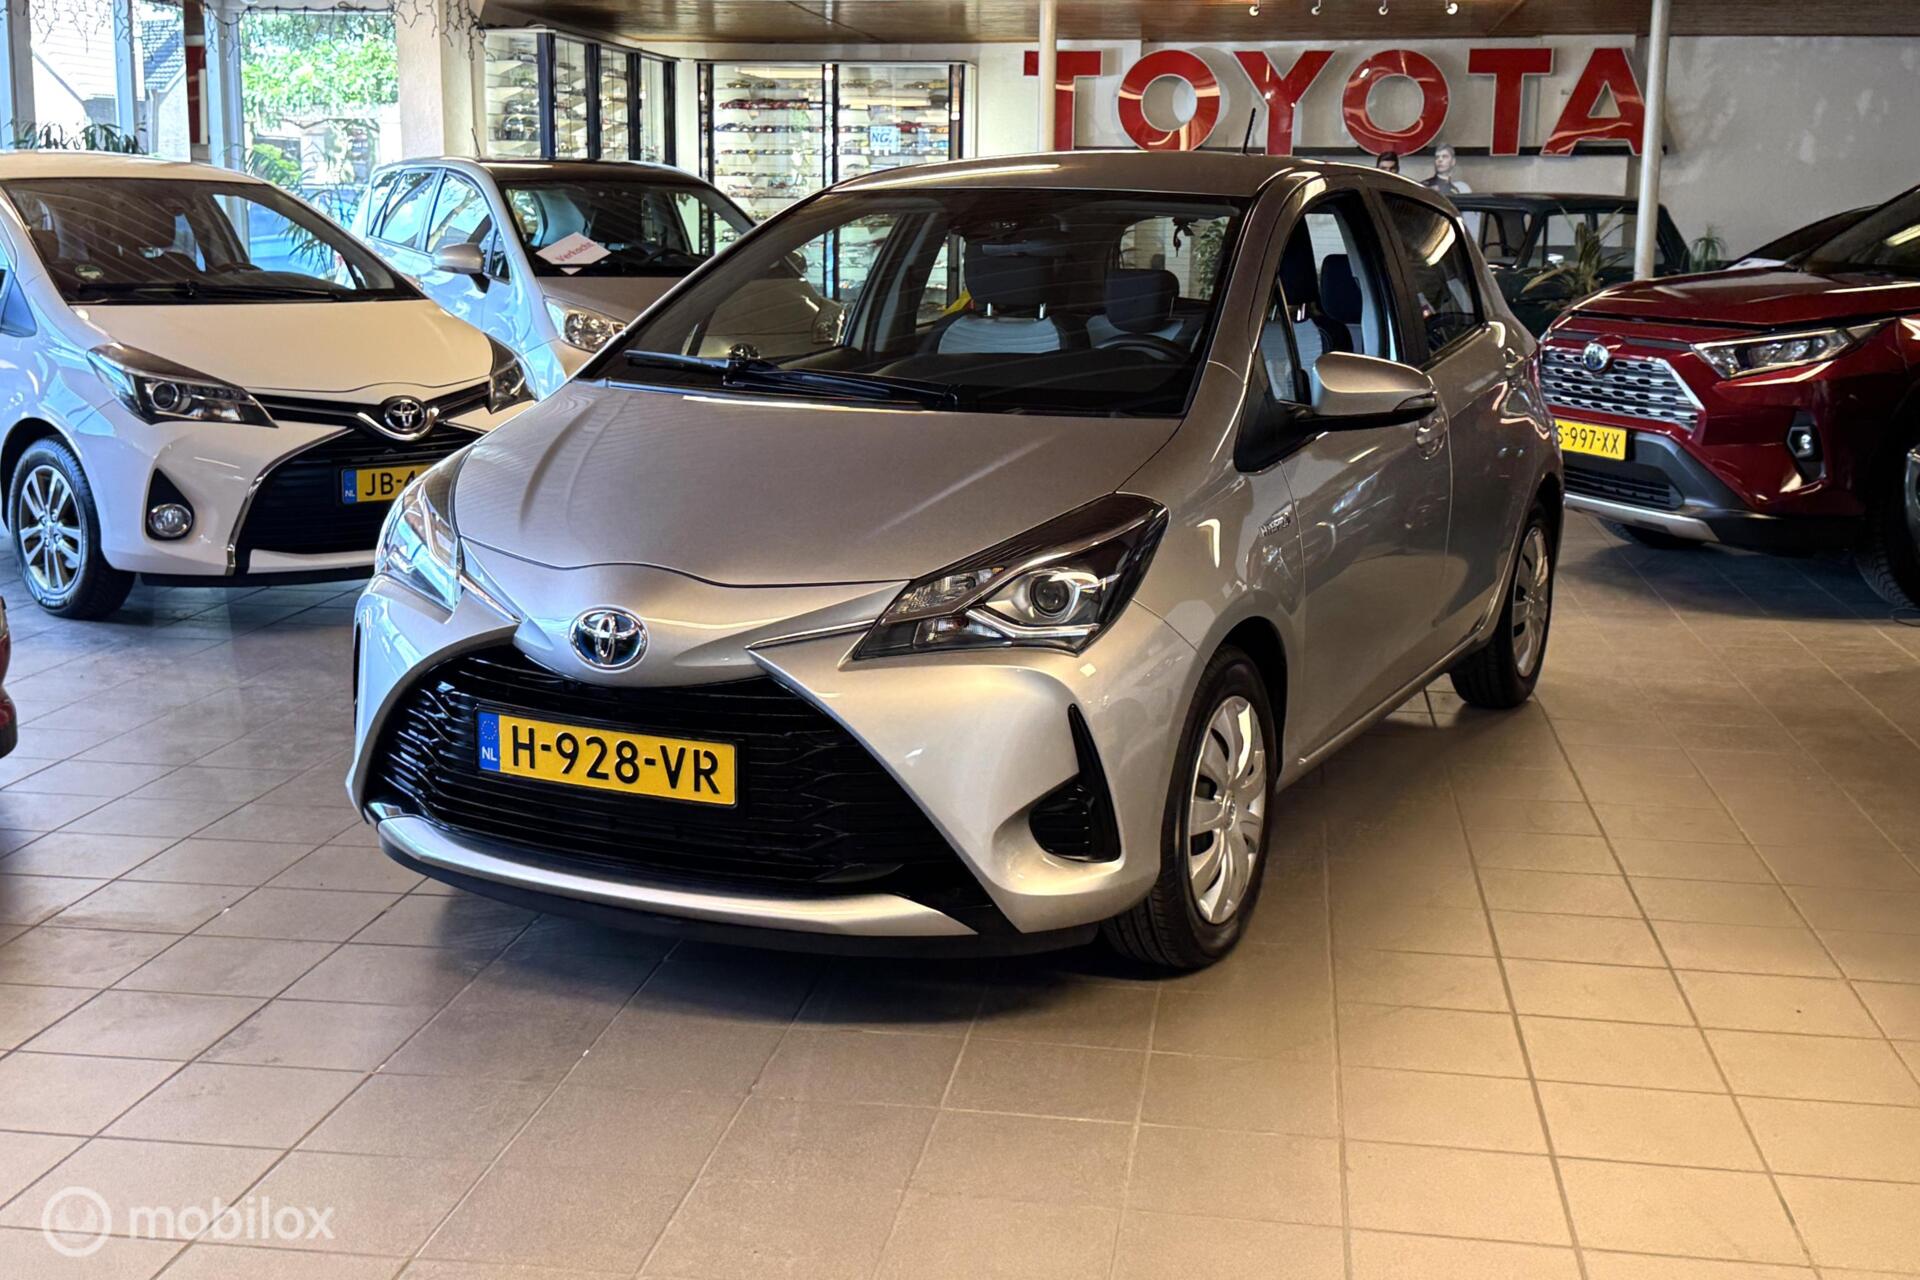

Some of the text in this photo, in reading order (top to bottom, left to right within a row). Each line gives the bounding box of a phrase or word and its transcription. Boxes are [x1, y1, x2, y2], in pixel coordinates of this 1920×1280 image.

[1024, 49, 1645, 156] TOYOTA
[344, 489, 355, 497] NL
[481, 746, 498, 762] NL
[511, 725, 720, 795] H-928-VR
